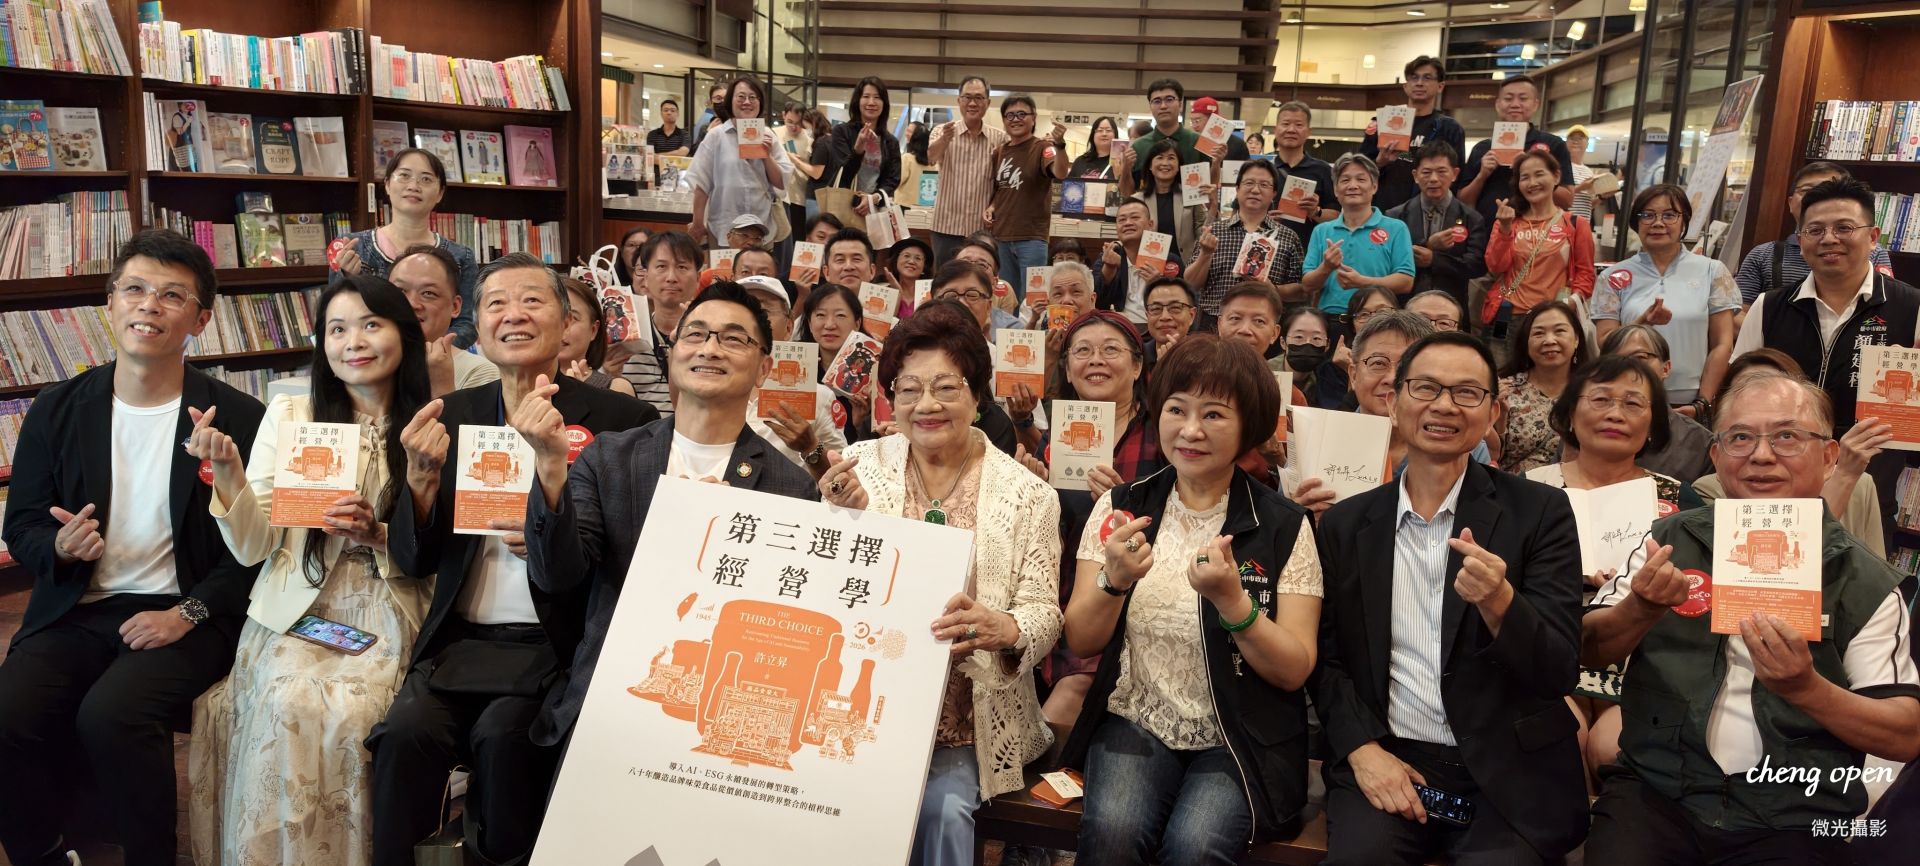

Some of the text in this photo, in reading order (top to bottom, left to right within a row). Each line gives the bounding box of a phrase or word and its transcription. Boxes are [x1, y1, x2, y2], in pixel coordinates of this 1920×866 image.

[299, 426, 339, 436] 第三選擇
[478, 430, 516, 441] 第三選擇
[477, 441, 515, 451] 經營學
[1742, 504, 1793, 515] 第三選擇
[1742, 517, 1793, 528] 經營學
[724, 511, 884, 567] 第三選擇
[712, 553, 871, 609] 經營學
[1240, 574, 1269, 584] 中市政府
[695, 612, 712, 622] 1945
[740, 612, 825, 636] THIRD CHOICE
[753, 651, 788, 669] 許立昇
